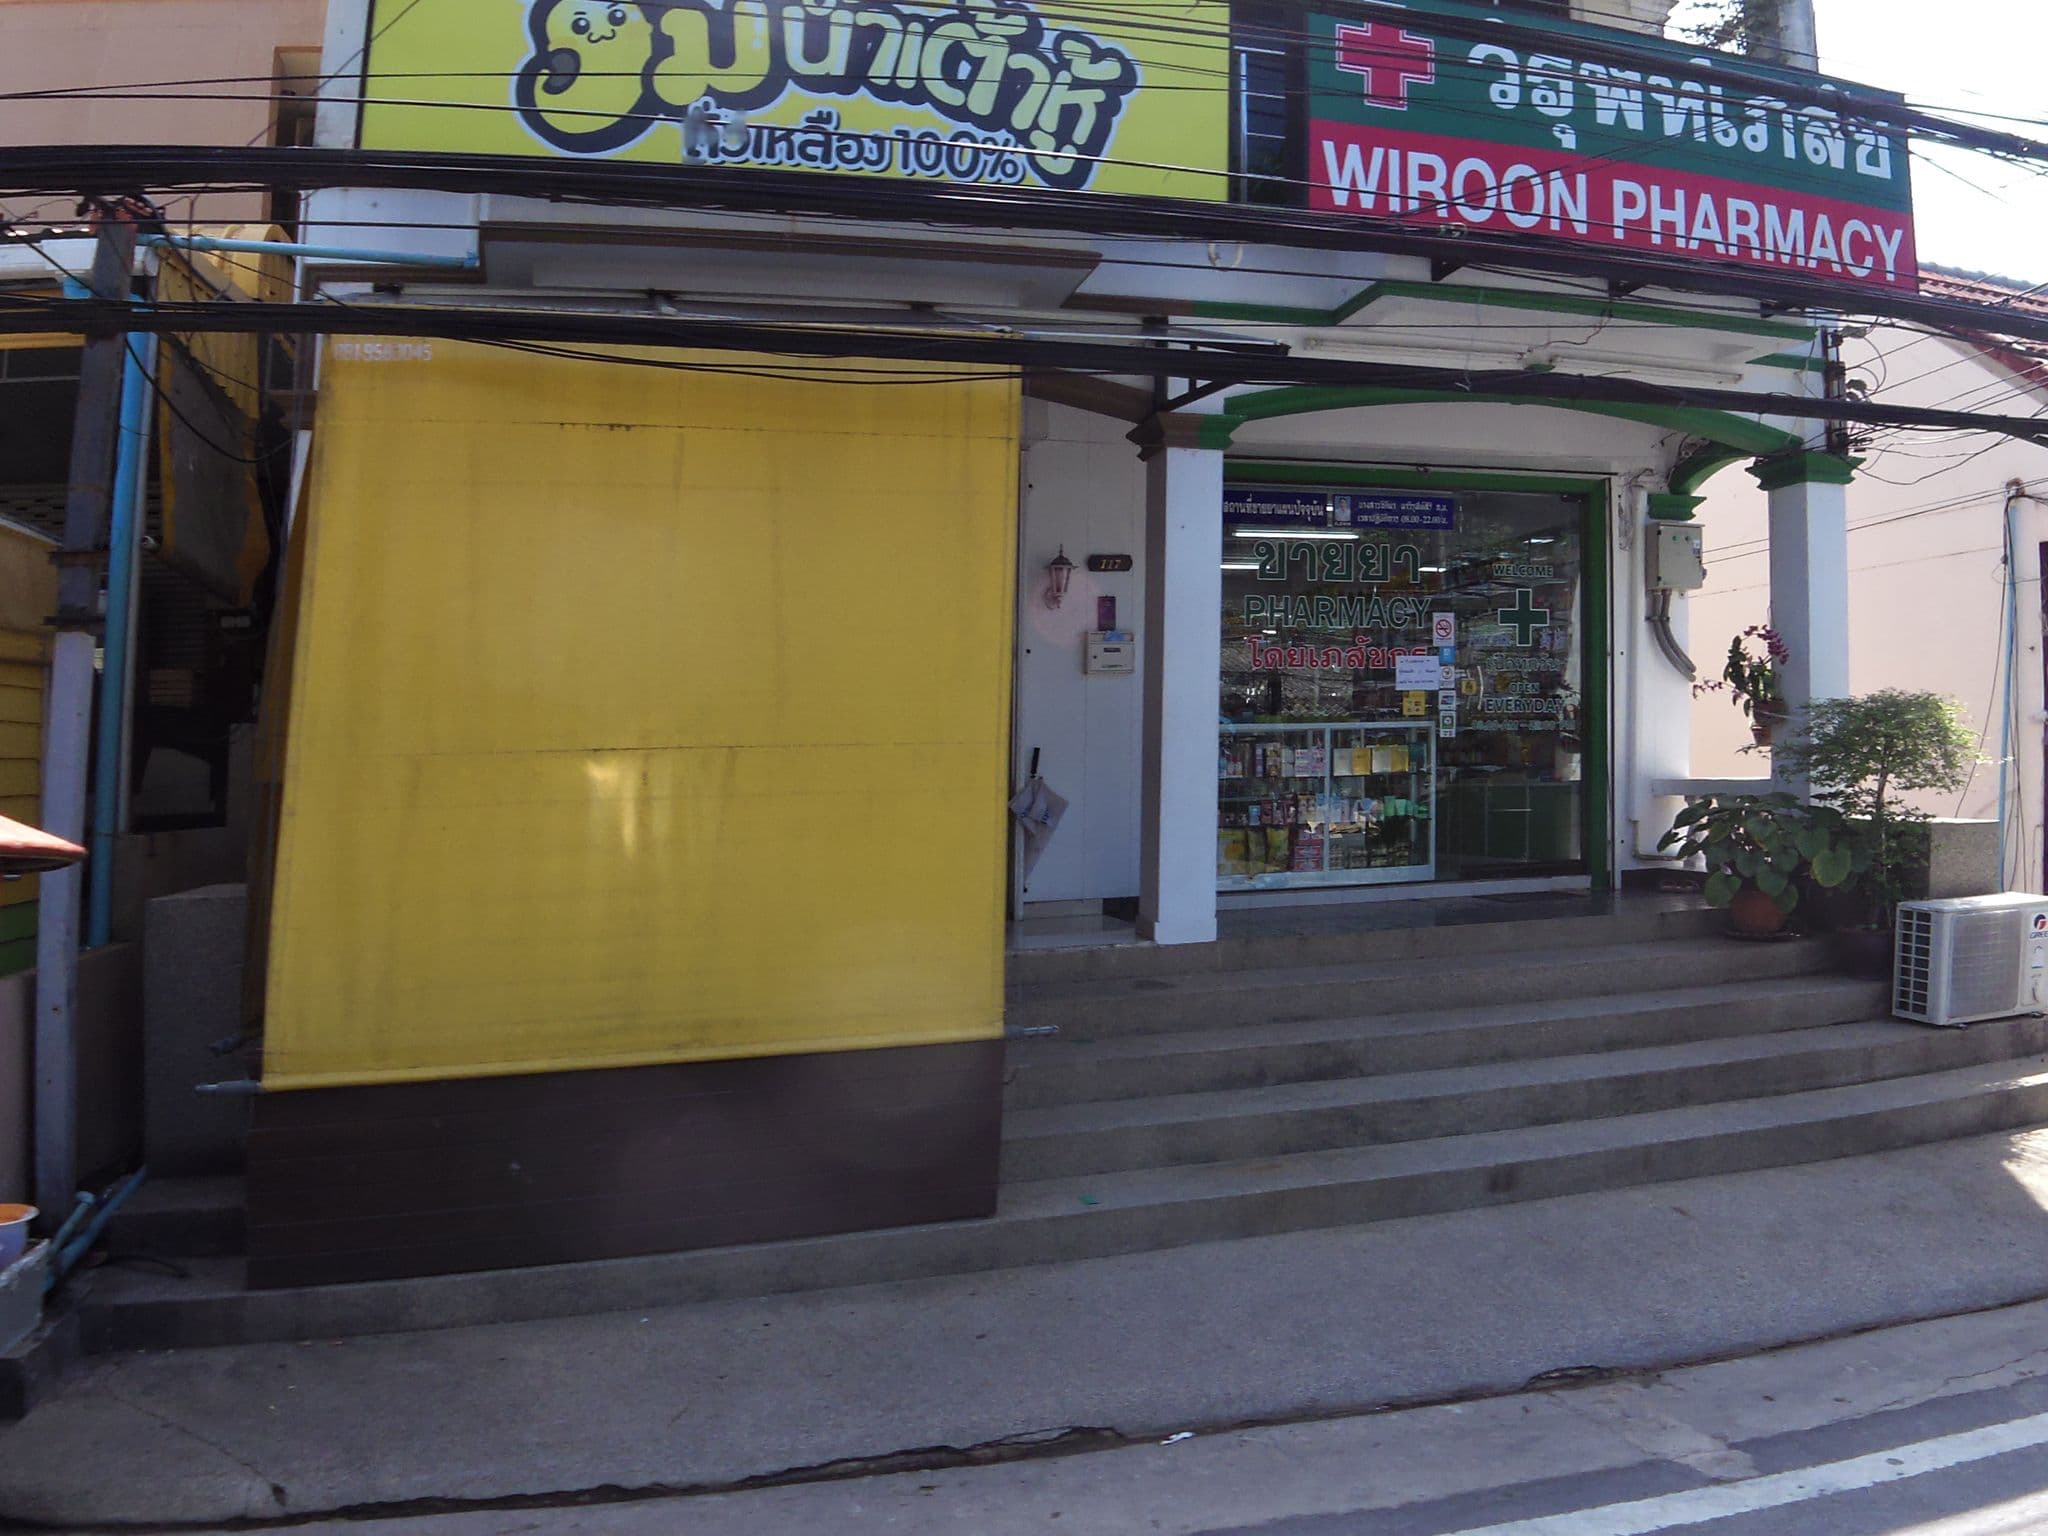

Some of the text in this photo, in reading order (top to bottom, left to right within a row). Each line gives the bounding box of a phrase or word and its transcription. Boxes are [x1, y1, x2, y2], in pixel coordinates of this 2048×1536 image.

[1322, 140, 1903, 281] WIROON PHARMACY
[1254, 541, 1421, 583] ขายยา
[1492, 564, 1554, 577] WELCOME
[1244, 595, 1432, 628] PHARMACY
[1510, 682, 1541, 694] OPEN
[1485, 697, 1565, 713] EVERYDAY
